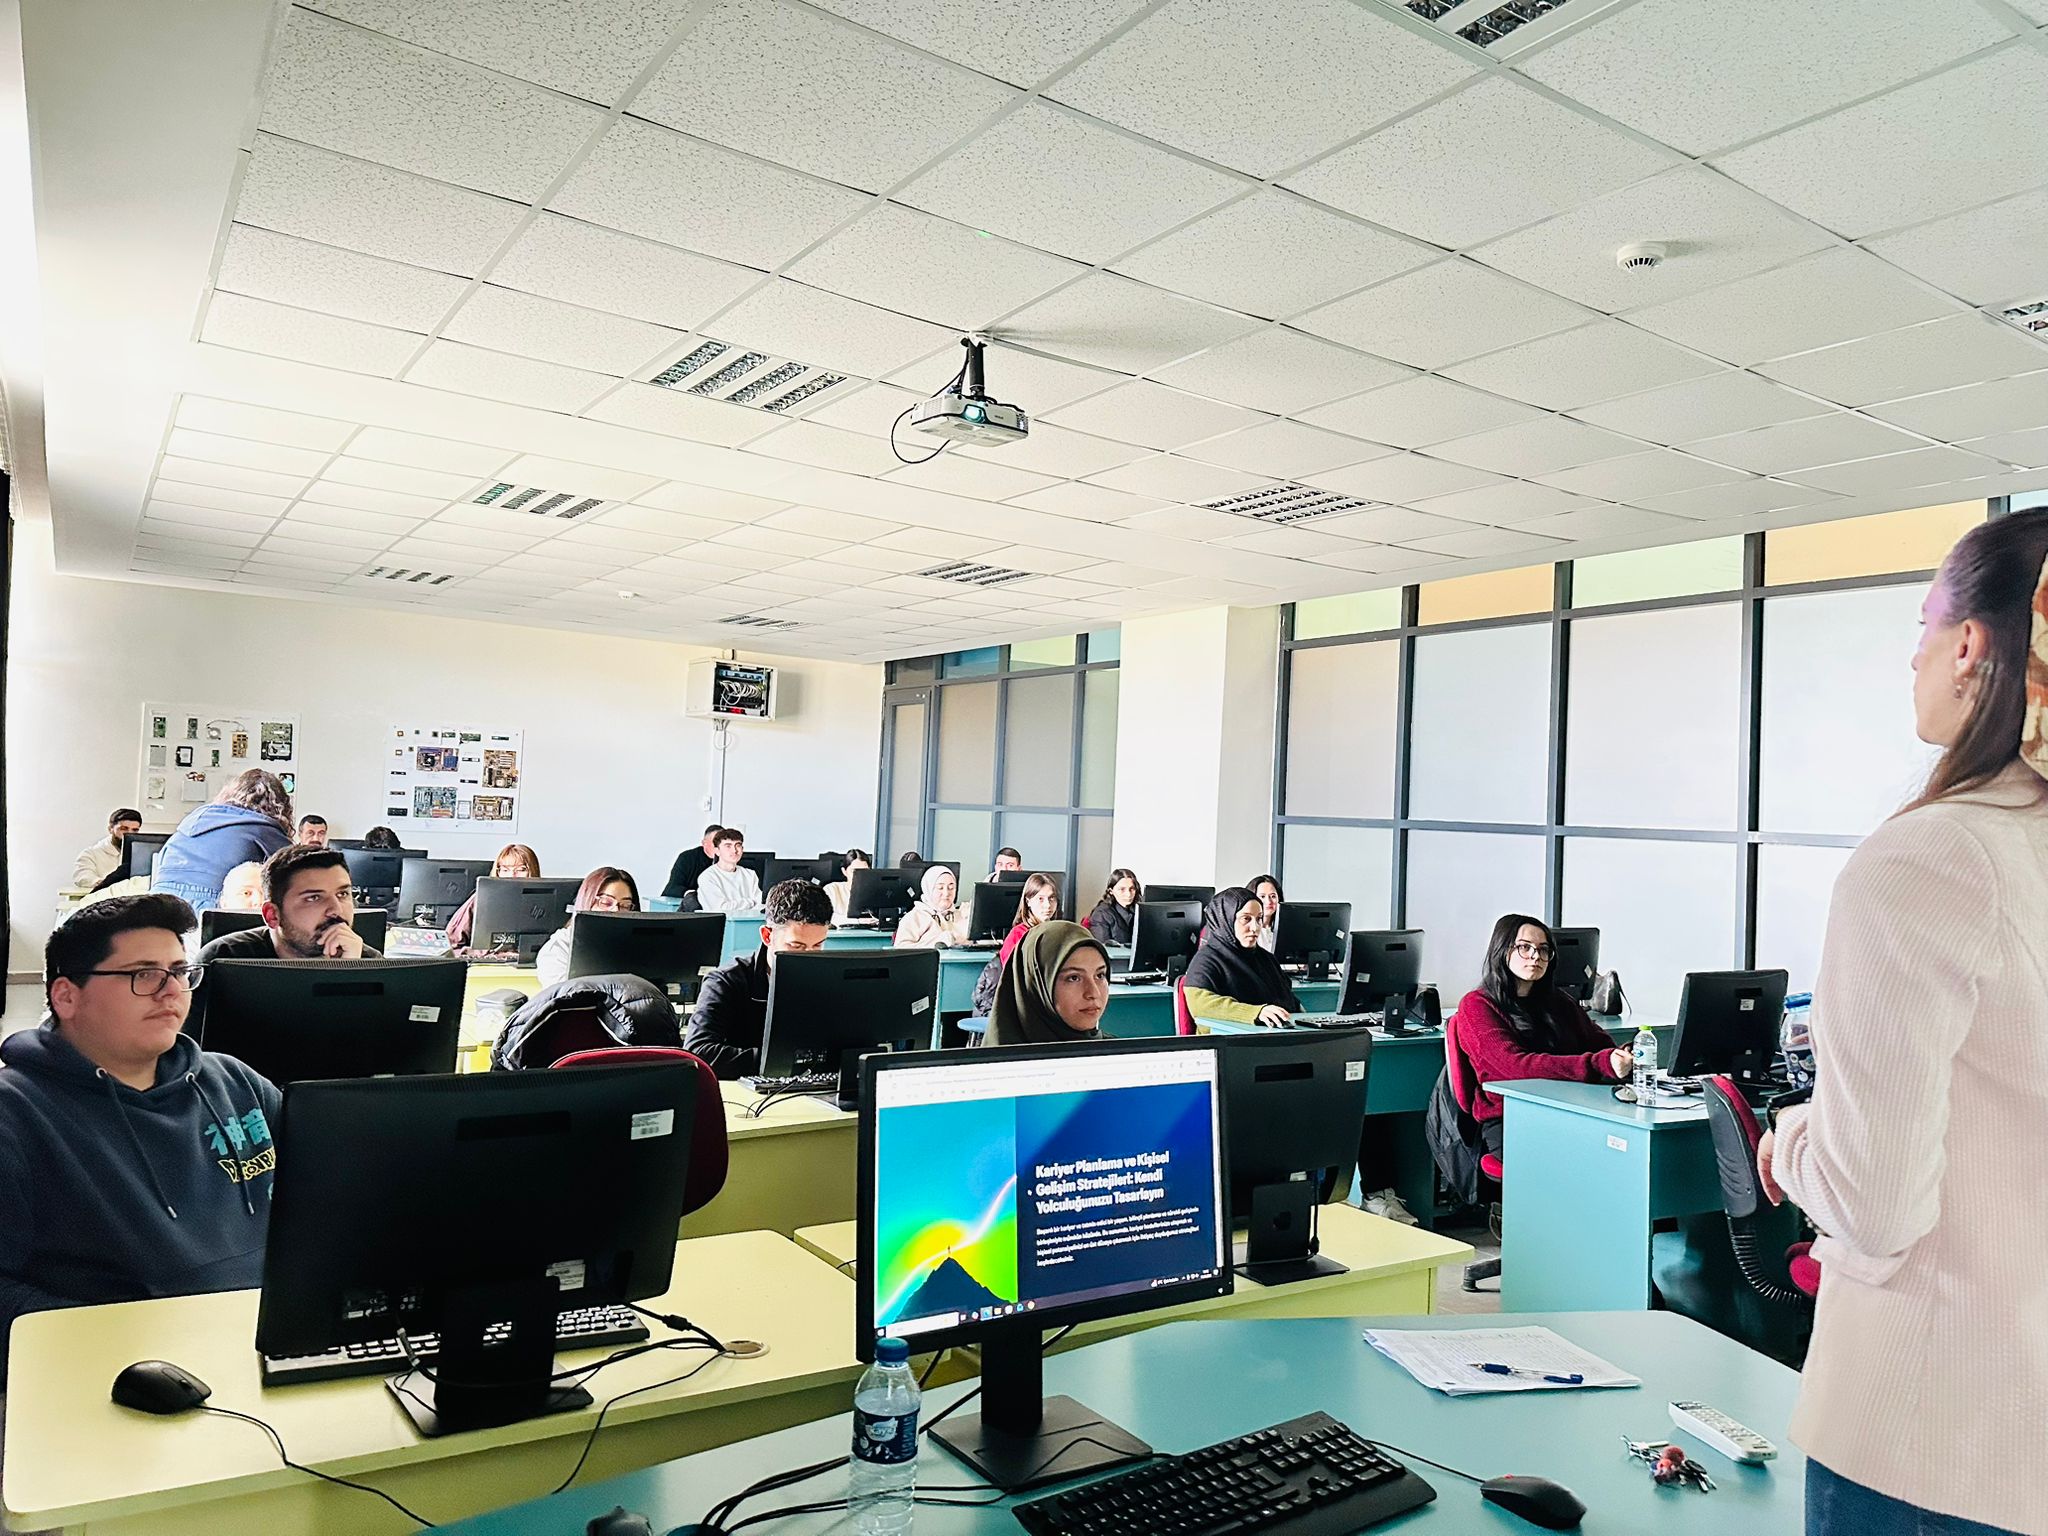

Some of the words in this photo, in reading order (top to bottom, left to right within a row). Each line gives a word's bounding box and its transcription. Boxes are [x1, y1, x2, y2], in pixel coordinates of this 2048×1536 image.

[1035, 1164, 1074, 1179] Kariyer
[1075, 1158, 1122, 1174] Planlama
[1124, 1156, 1137, 1168] ve
[1137, 1151, 1170, 1167] Kişisel
[1035, 1181, 1076, 1197] Gelişim
[1076, 1175, 1134, 1190] Stratejileri:
[1134, 1169, 1163, 1184] Kendi
[1035, 1194, 1113, 1215] Yolculuğunuzu
[1113, 1187, 1164, 1203] Tasarlayın
